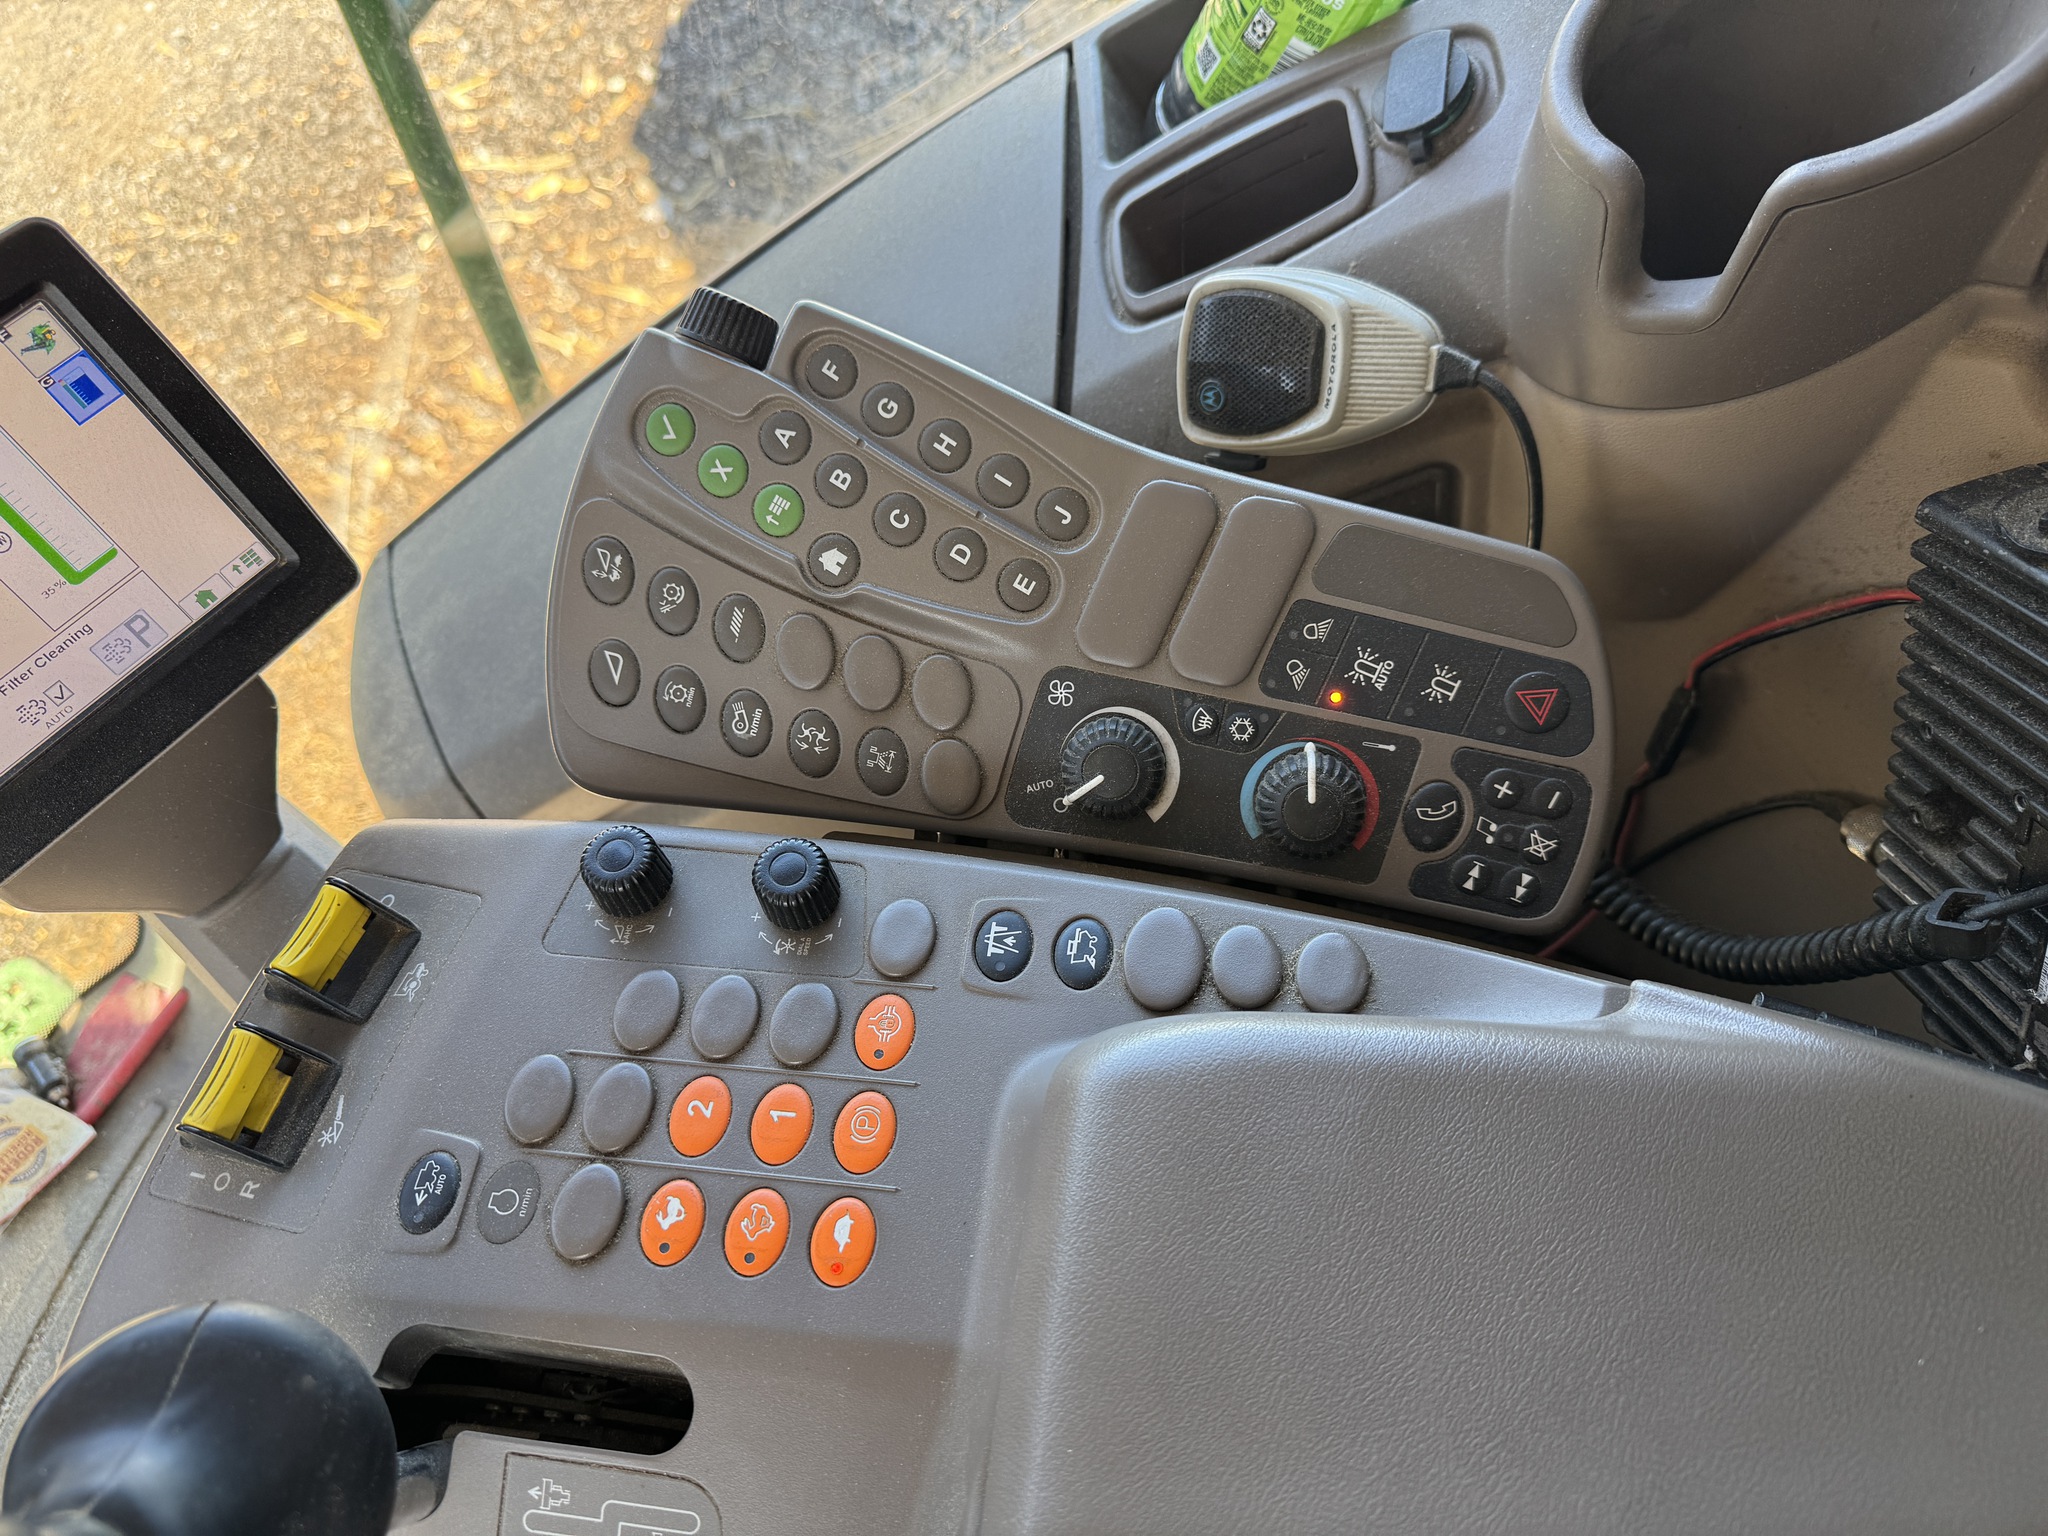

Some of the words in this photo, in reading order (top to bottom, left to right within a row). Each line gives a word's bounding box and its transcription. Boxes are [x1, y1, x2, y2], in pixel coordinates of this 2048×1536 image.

[821, 358, 840, 382] F
[1323, 323, 1338, 409] MOTOROLA
[40, 376, 54, 388] G
[877, 397, 899, 419] G
[774, 428, 797, 450] A
[932, 432, 958, 457] H
[828, 467, 852, 492] B
[993, 472, 1013, 488] I
[889, 508, 910, 529] C
[1054, 504, 1072, 525] J
[949, 543, 972, 566] D
[41, 578, 67, 599] 35%
[1012, 572, 1037, 596] E
[123, 614, 152, 649] P
[0, 666, 35, 697] Filter
[34, 623, 94, 669] Cleaning
[1374, 660, 1395, 692] AUTO
[686, 686, 696, 708] n/min
[45, 704, 74, 730] AUTO
[749, 708, 763, 737] n/min
[1026, 779, 1054, 794] AUTO
[624, 924, 633, 940] AHC
[803, 937, 811, 956] SPEED
[687, 1099, 714, 1119] 2
[769, 1109, 797, 1124] 1
[855, 1115, 876, 1131] P
[239, 1180, 261, 1199] R
[434, 1174, 447, 1195] AUTO
[519, 1187, 533, 1218] n/min
